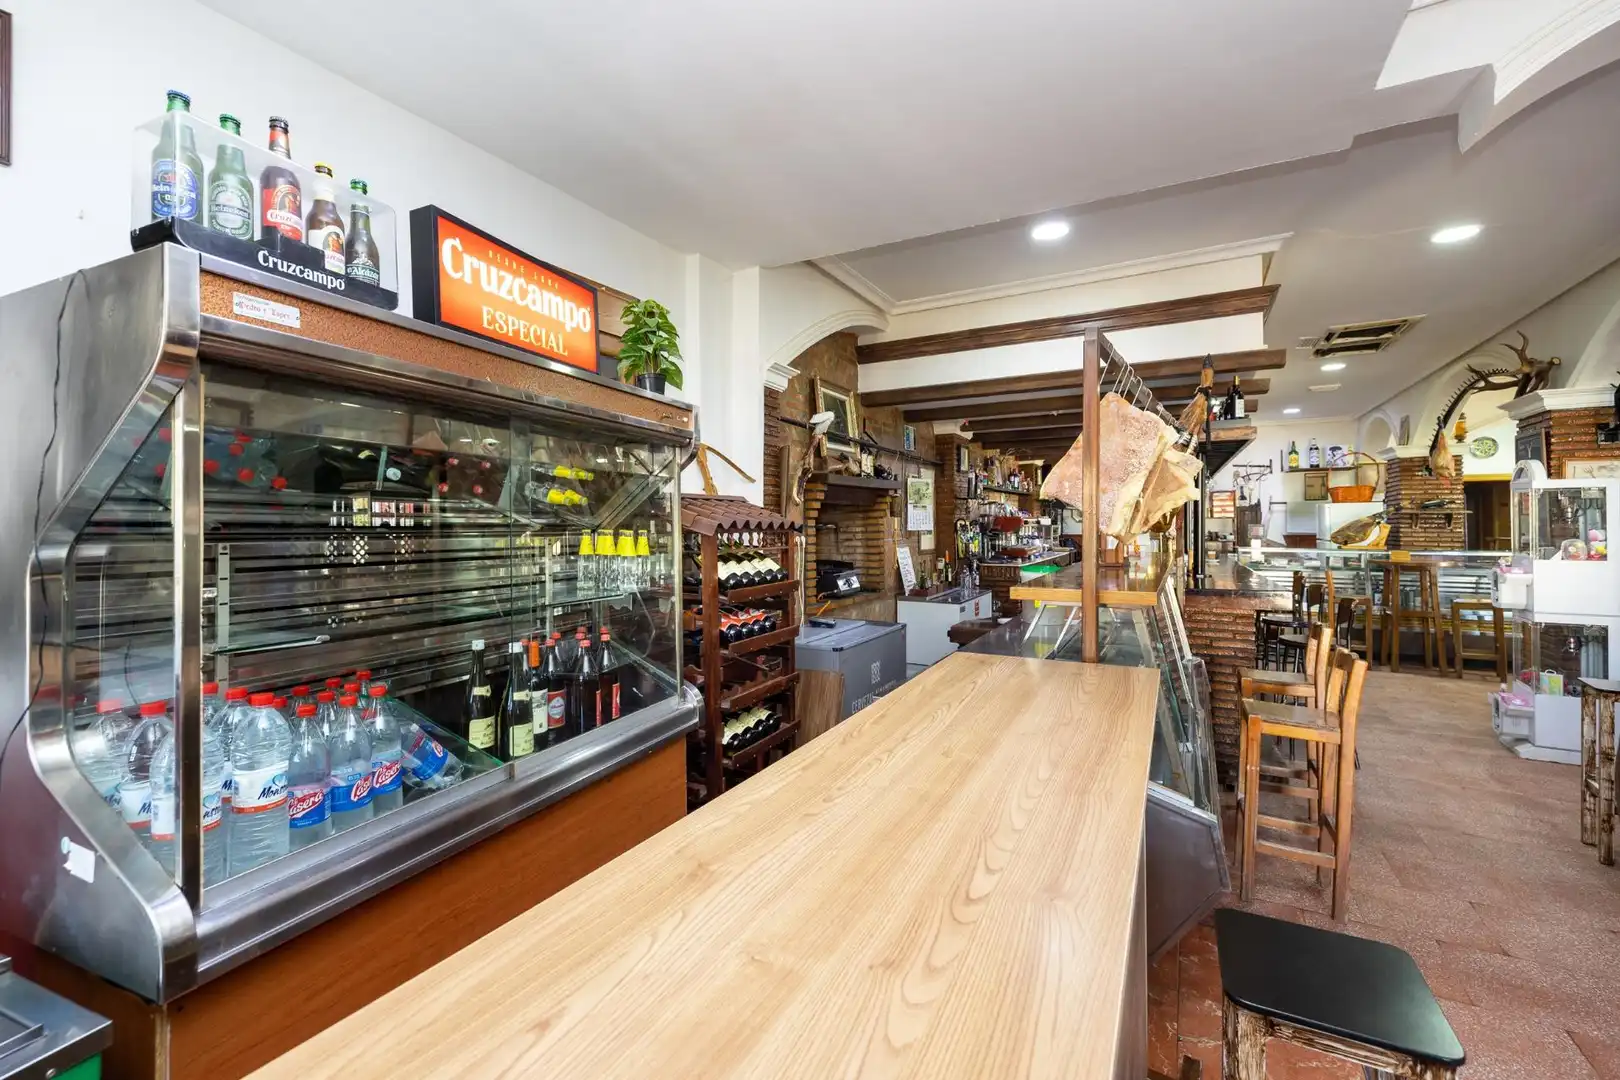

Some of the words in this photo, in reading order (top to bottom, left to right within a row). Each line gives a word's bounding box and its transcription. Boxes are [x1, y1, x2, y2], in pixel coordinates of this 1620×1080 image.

[257, 249, 346, 291] Cruzcampo
[441, 236, 592, 333] Cruzcampo
[482, 305, 569, 357] ESPECIAL
